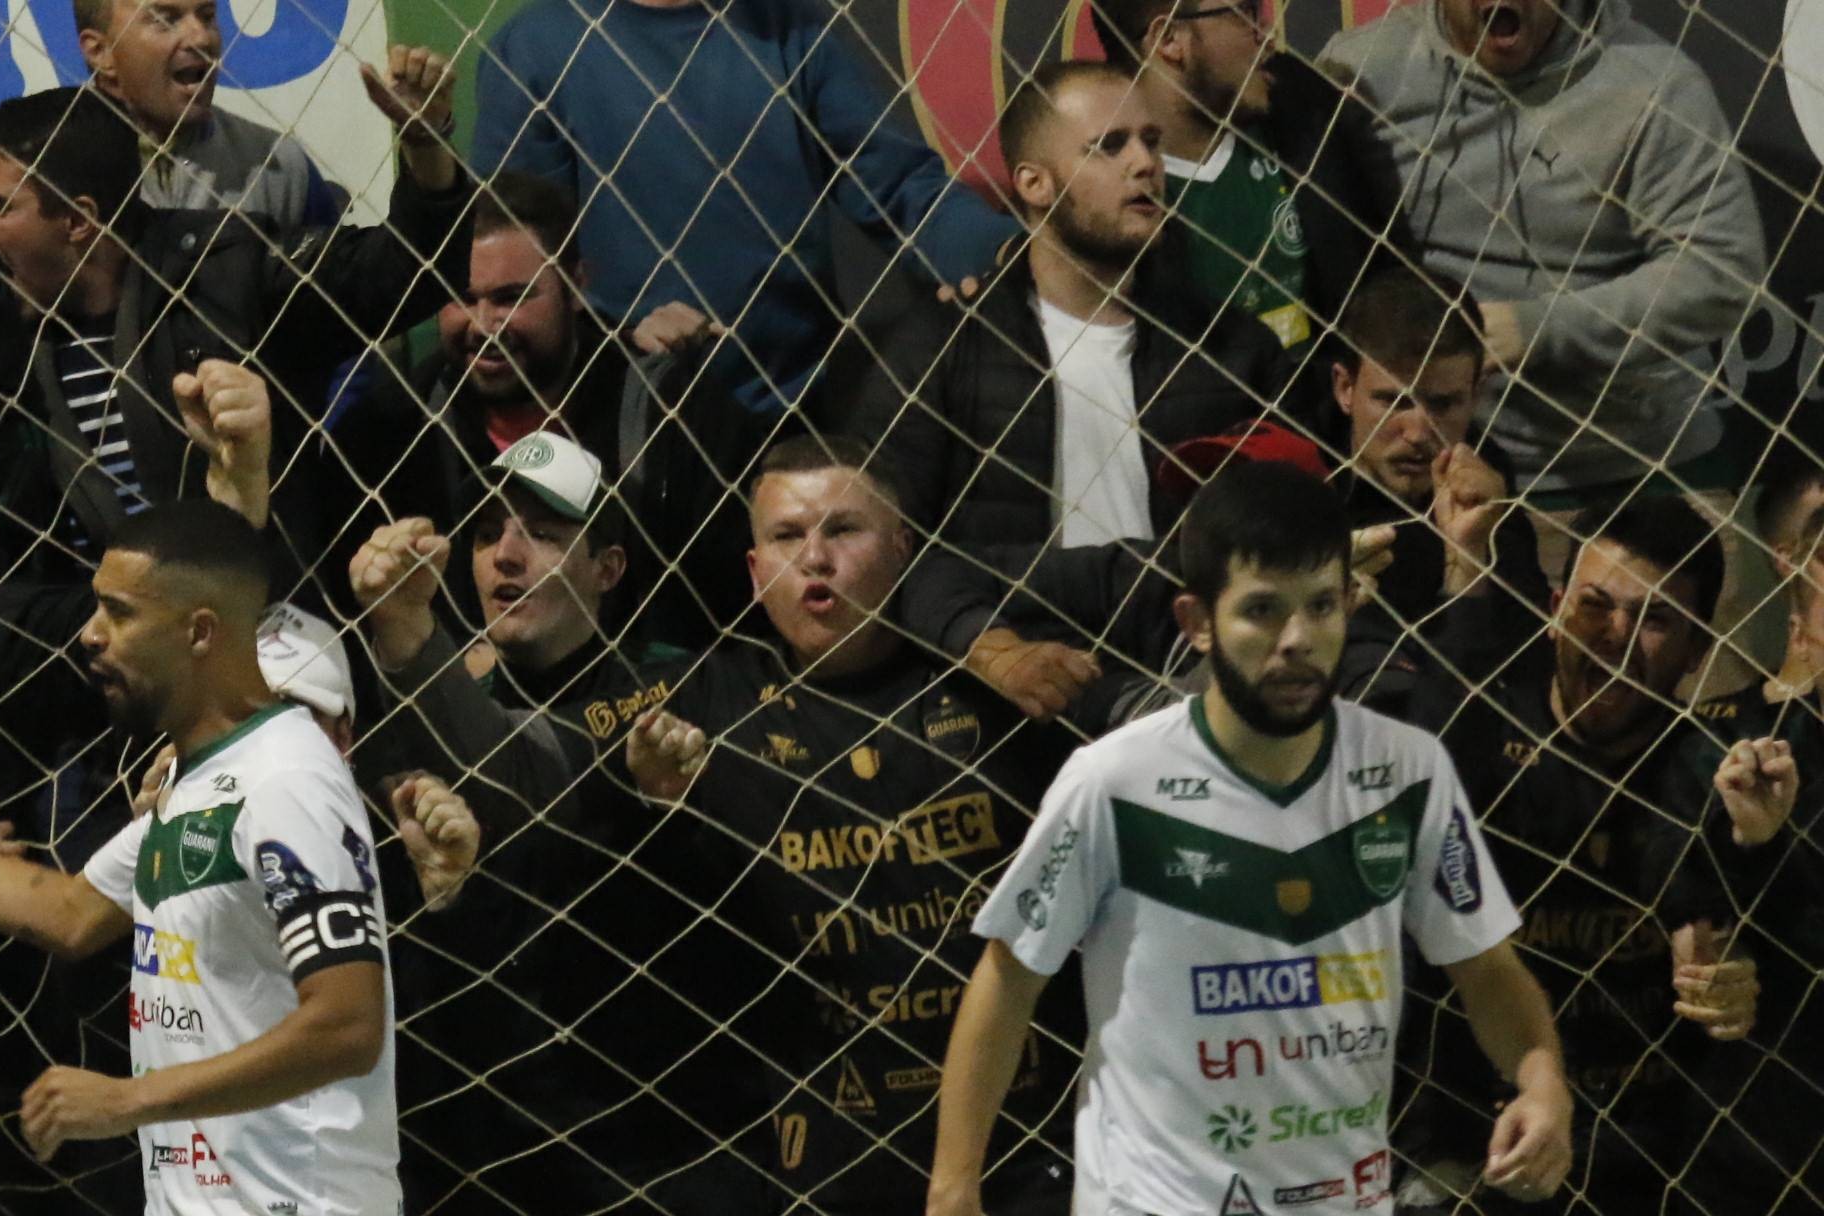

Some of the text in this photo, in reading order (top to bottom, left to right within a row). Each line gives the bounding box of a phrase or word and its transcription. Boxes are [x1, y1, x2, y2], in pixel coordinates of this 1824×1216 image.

[1157, 777, 1212, 795] MTX
[1196, 962, 1314, 1010] BAKOF
[1279, 1021, 1388, 1060] uniban
